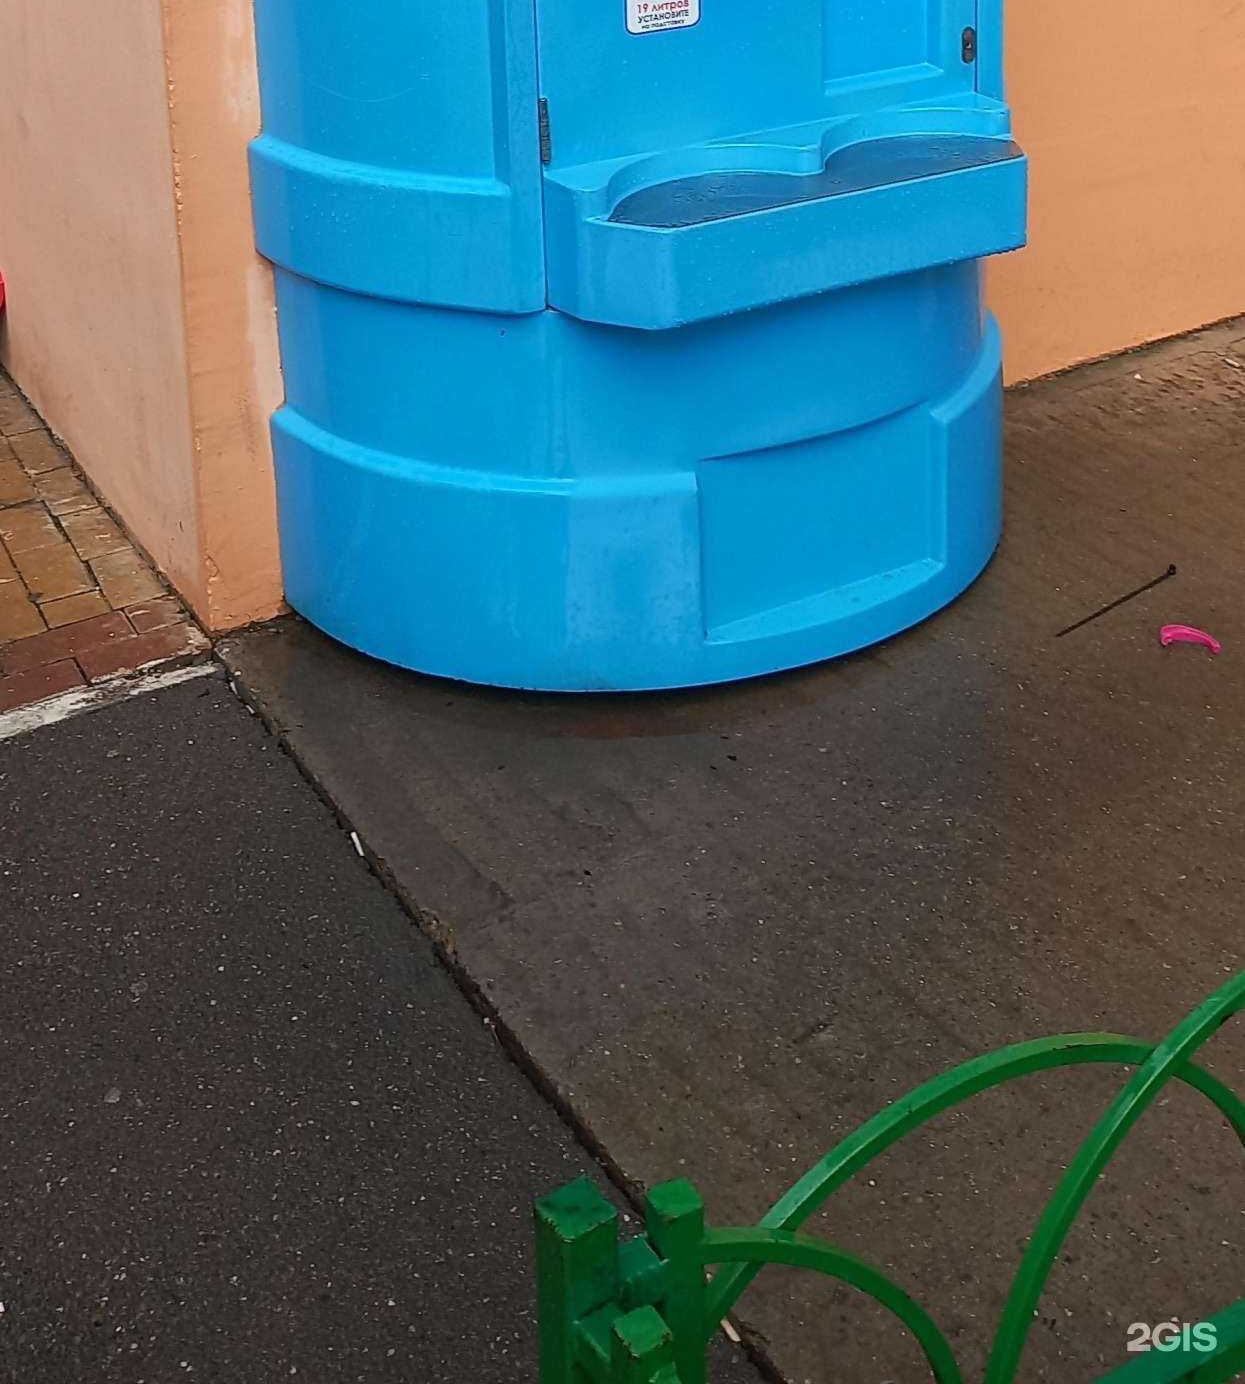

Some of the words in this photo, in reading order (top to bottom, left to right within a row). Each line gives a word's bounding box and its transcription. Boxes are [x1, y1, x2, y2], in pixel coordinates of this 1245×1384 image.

[637, 3, 649, 13] 19
[652, 0, 690, 12] литров
[637, 9, 690, 24] УСТАНОВИТЕ
